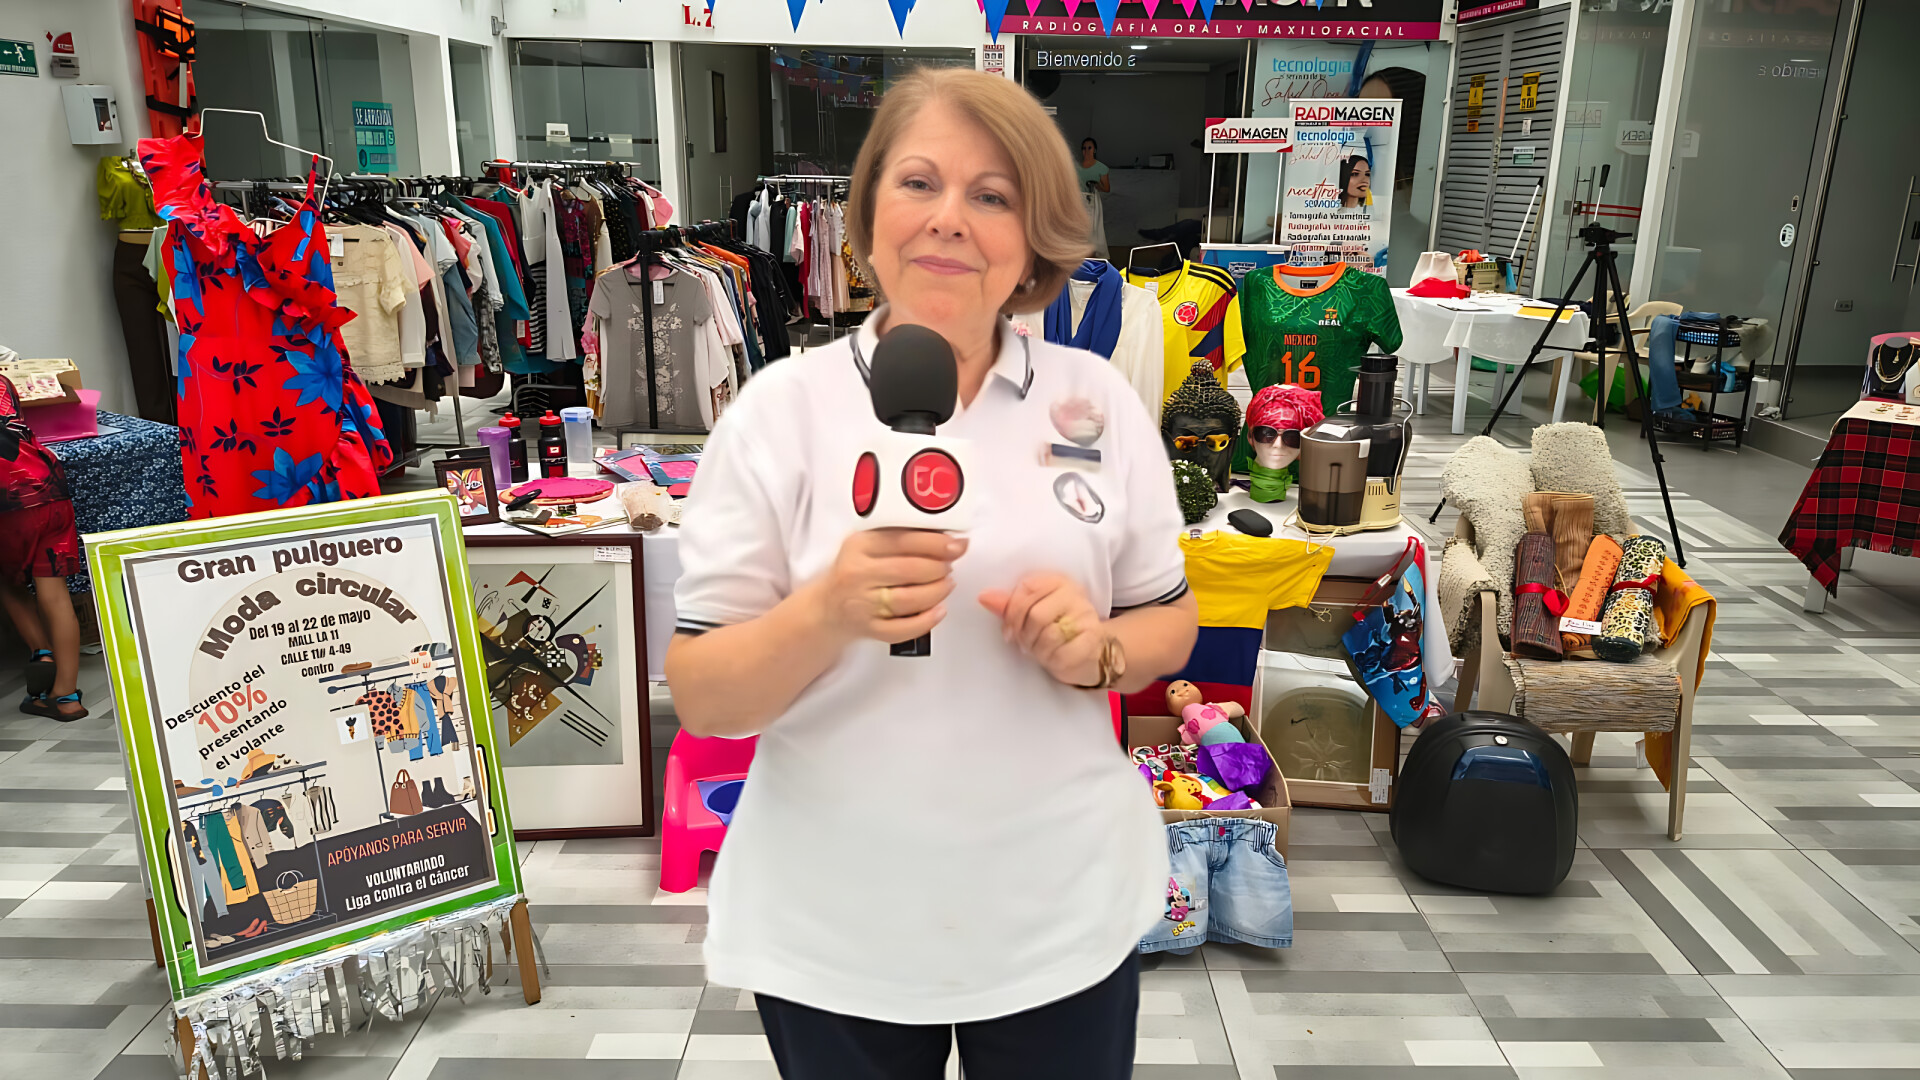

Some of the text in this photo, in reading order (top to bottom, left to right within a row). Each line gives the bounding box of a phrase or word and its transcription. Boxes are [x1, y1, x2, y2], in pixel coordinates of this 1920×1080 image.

[1022, 20, 1405, 36] RADIOGAFIA ORAL Y MAXILOFACIAL
[1037, 50, 1122, 67] Bienvenido
[1295, 106, 1395, 121] RADIMAGEN
[1211, 127, 1288, 139] RADIMAGEN
[1281, 351, 1321, 389] 16
[177, 536, 403, 583] Gran pulguero
[199, 572, 417, 660] Moda circular
[249, 609, 371, 640] Del 19 al 22 de mayo
[281, 650, 309, 665] CALLE
[329, 642, 352, 656] 4-49
[288, 629, 339, 648] MALL LA 11
[165, 664, 266, 730] Descuento del
[198, 684, 268, 734] 10%
[198, 699, 287, 760] presentando
[215, 723, 285, 770] el volante
[392, 830, 424, 849] PARA
[426, 817, 467, 840] SERVIR
[365, 854, 445, 888] VOLUNTARIADO
[345, 894, 371, 912] Liga
[373, 881, 413, 903] Contra
[415, 878, 427, 890] el
